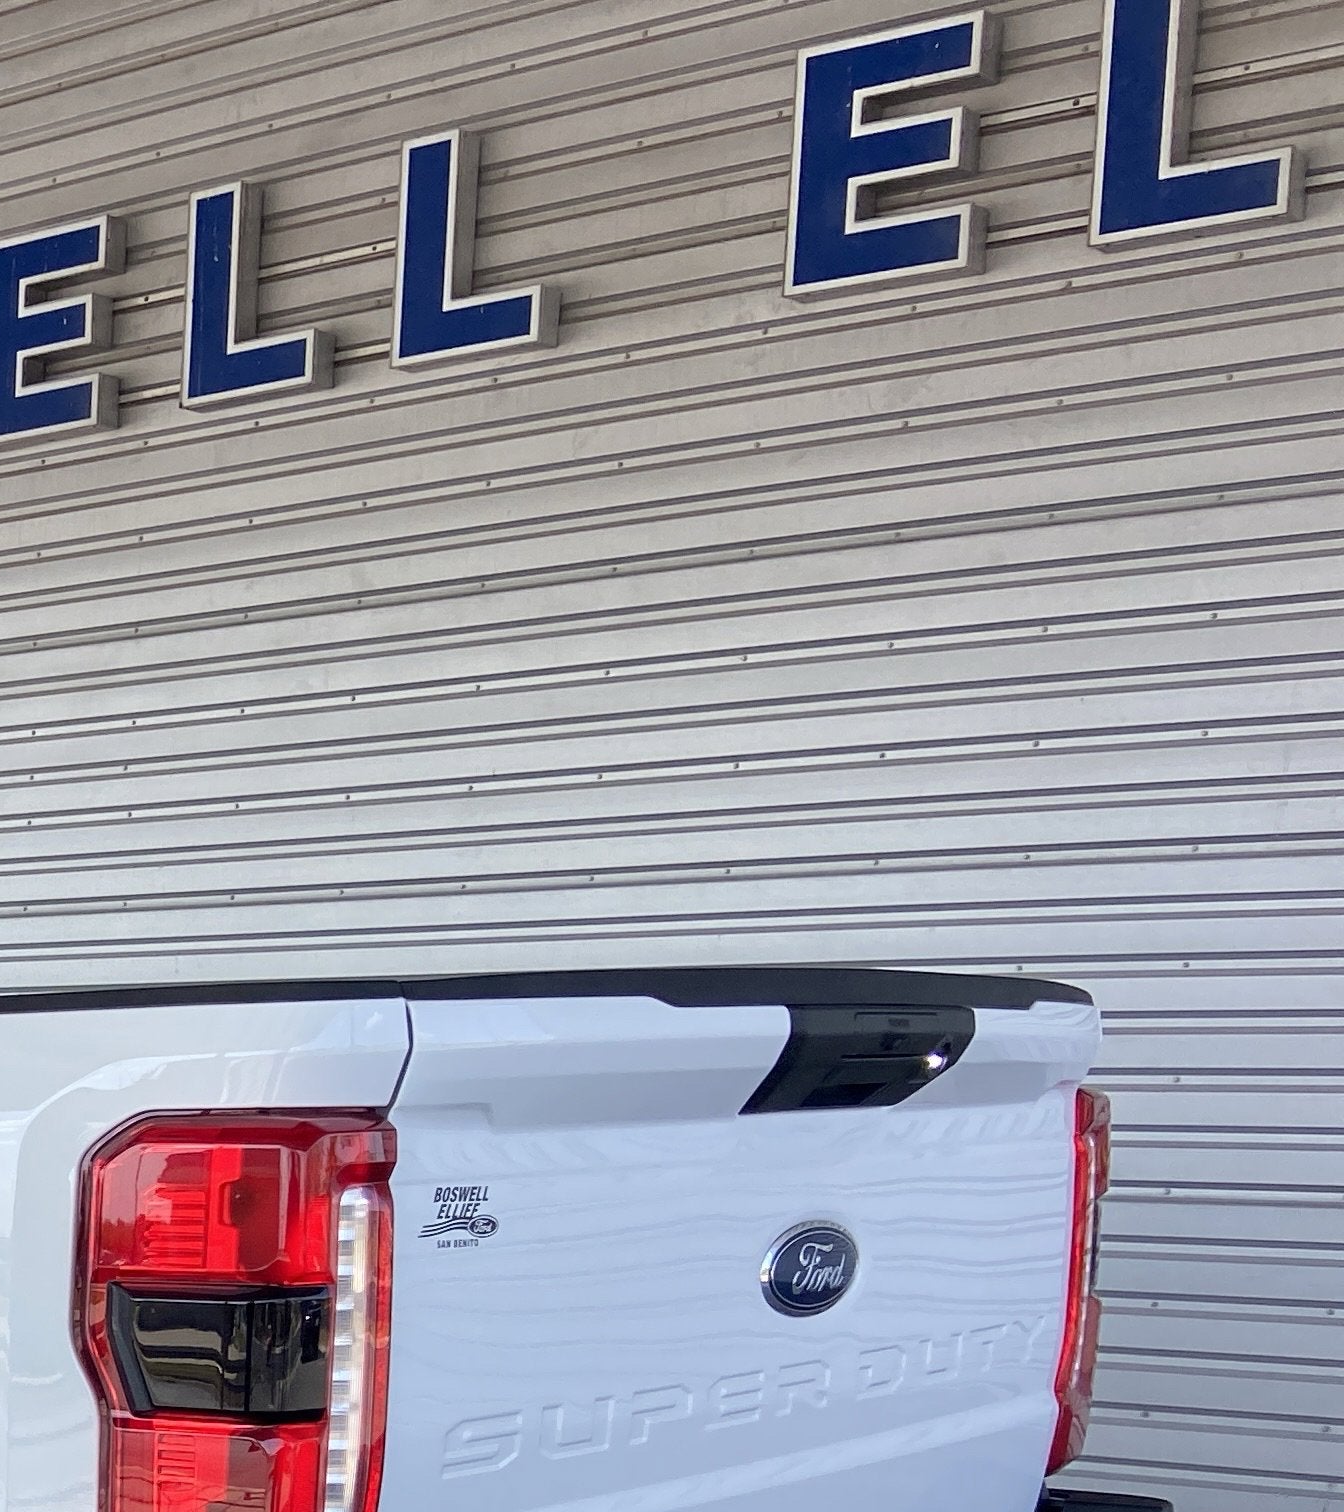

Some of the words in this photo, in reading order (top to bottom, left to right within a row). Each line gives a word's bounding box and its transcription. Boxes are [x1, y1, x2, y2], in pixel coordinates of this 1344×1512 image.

[433, 1185, 489, 1203] BOSWELL
[436, 1202, 481, 1220] ELLIFF
[437, 1239, 451, 1248] SAN
[453, 1238, 479, 1249] BENITO
[792, 1242, 846, 1296] Ford
[441, 1358, 833, 1481] SUPER
[856, 1313, 1050, 1401] DUTY
